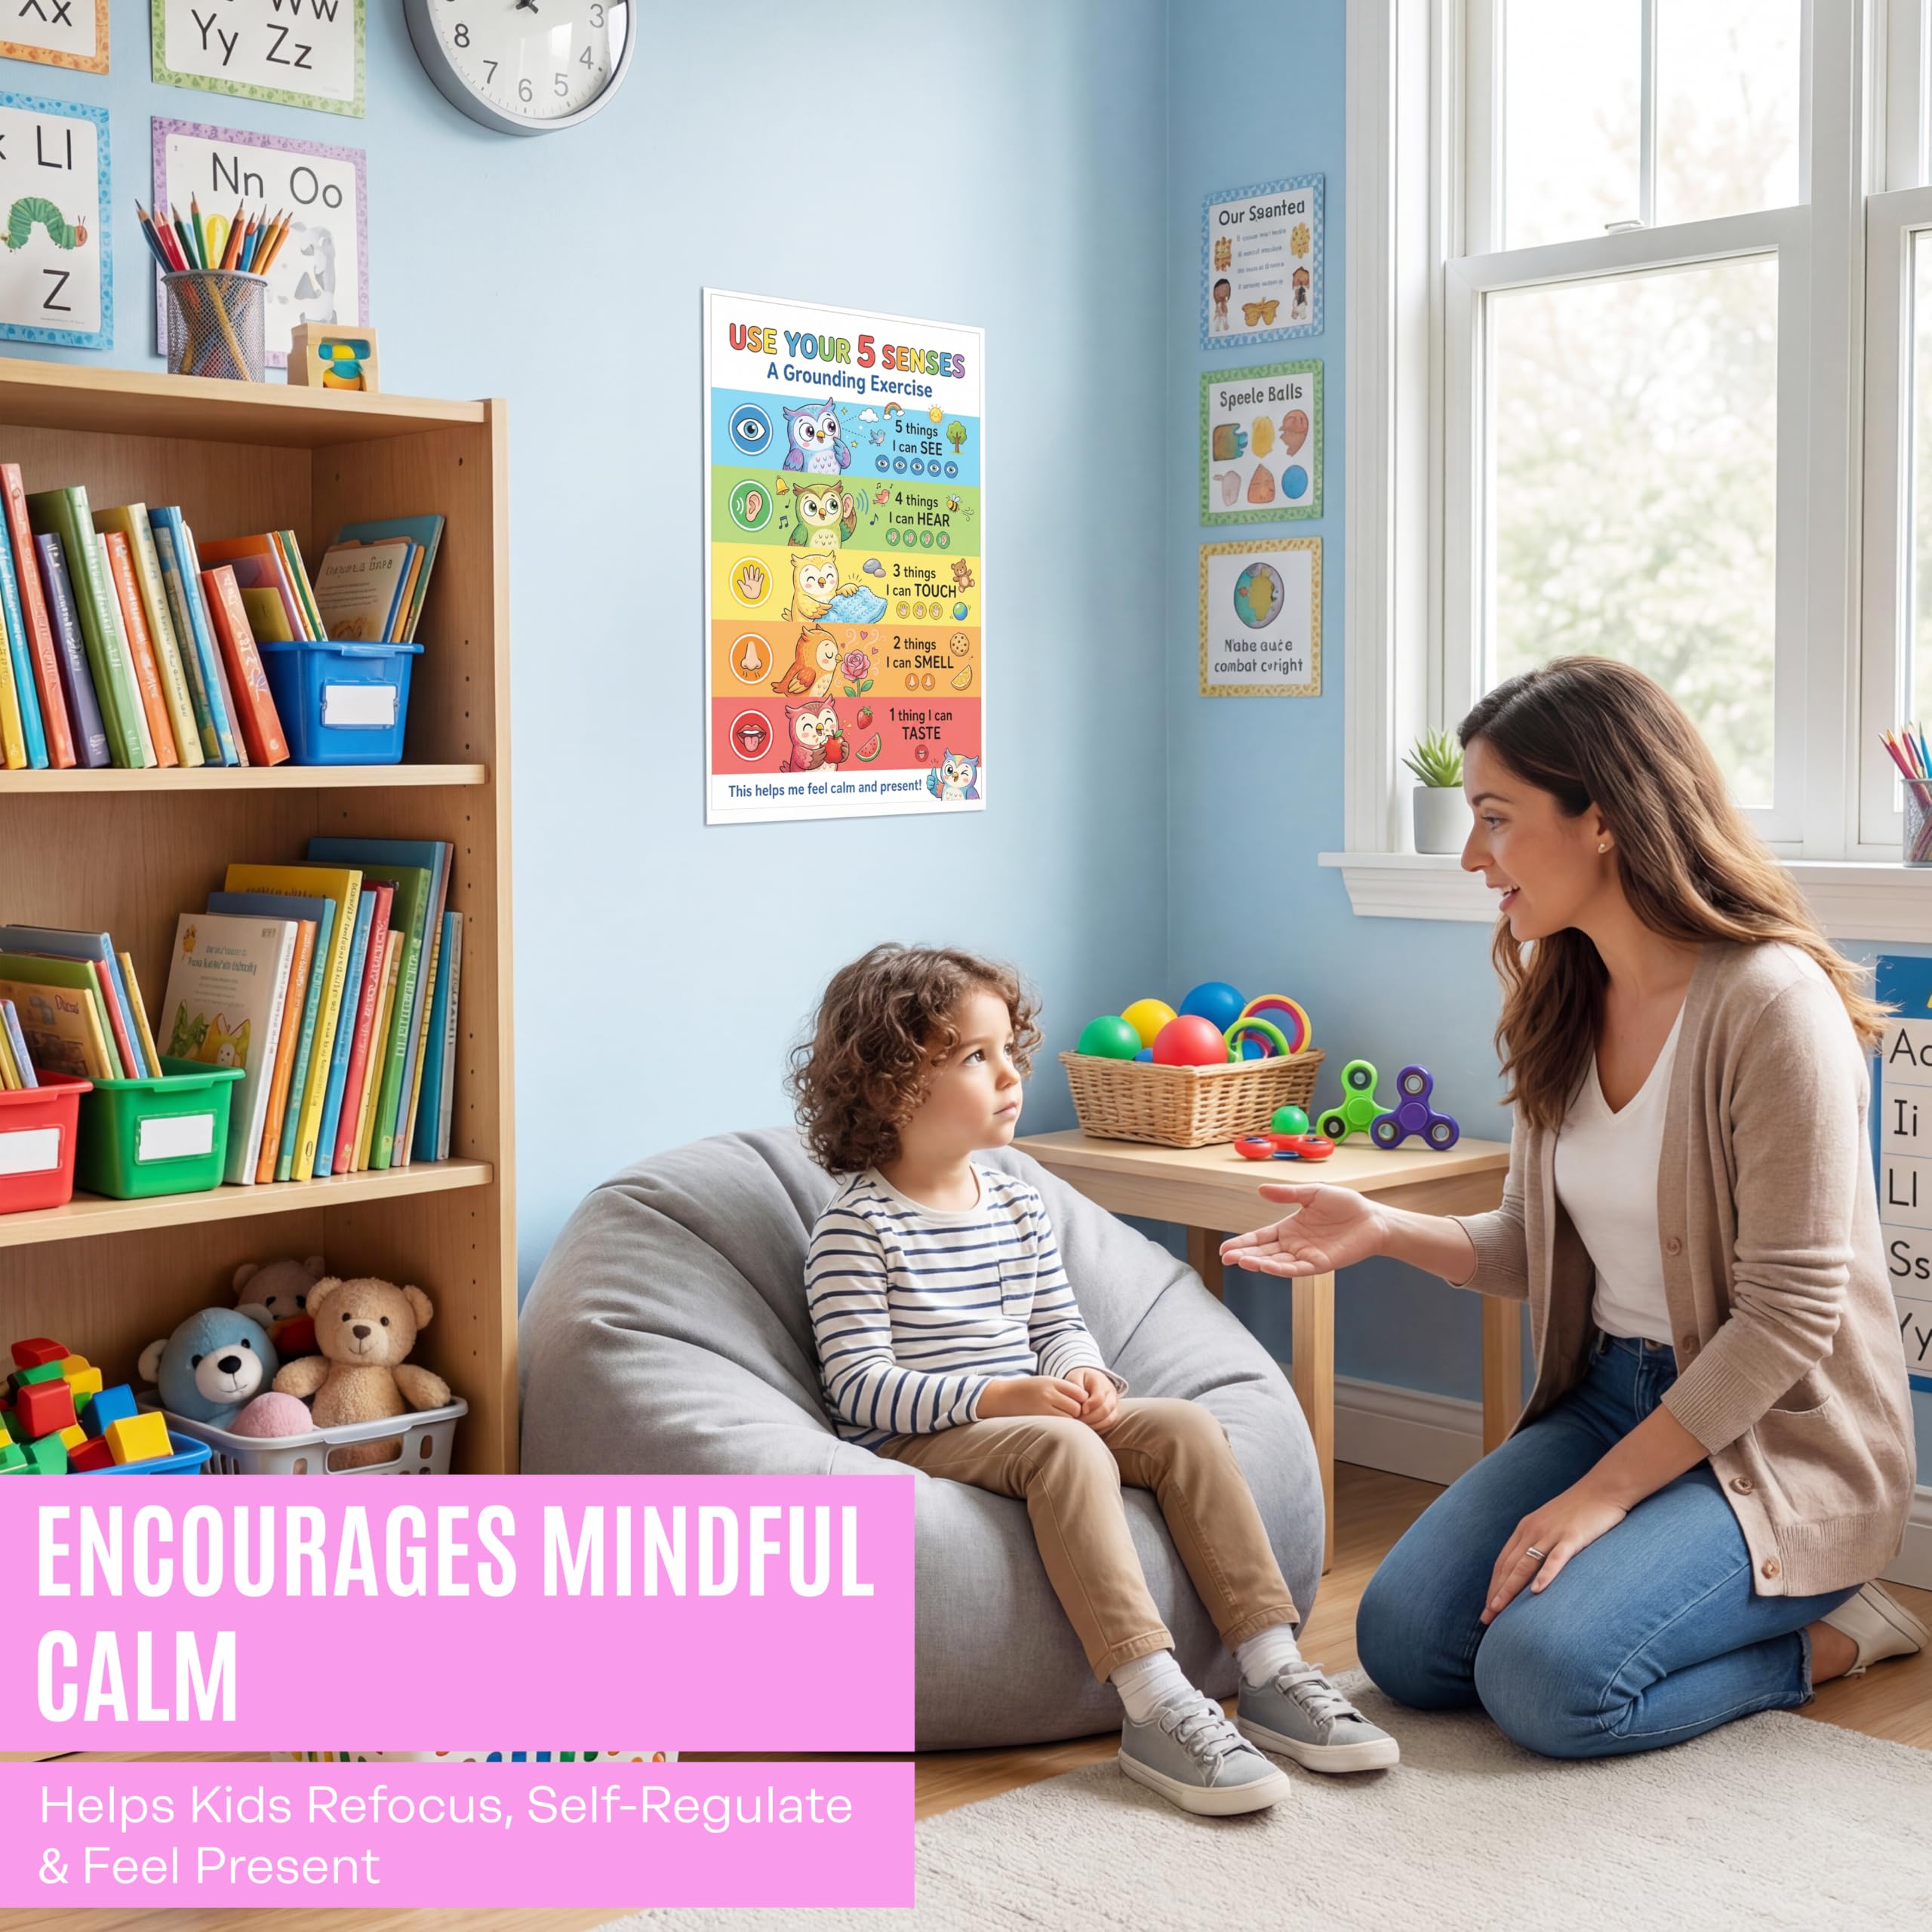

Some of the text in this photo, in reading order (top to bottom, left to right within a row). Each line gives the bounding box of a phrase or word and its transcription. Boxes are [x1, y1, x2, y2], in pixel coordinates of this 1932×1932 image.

[589, 3, 605, 29] 3
[191, 8, 312, 70] Yy Zz
[454, 23, 470, 48] 8
[579, 45, 595, 70] 4
[482, 60, 498, 85] 7
[518, 78, 533, 103] 6
[554, 72, 568, 97] 5
[212, 152, 343, 209] Nn Oo
[1218, 210, 1245, 226] Our
[729, 322, 966, 379] USE YOUR 5 SENSES
[767, 361, 933, 398] A Grounding Exercise
[1220, 383, 1303, 411] Speele Balls
[895, 420, 939, 439] 5 things
[893, 439, 943, 456] I can SEE
[895, 491, 939, 510] 4 things
[889, 511, 950, 527] I can HEAR
[893, 563, 937, 582] 3 things
[886, 583, 956, 598] I can TOUCH
[894, 635, 937, 654] 2 things
[886, 655, 954, 669] I can SMELL
[890, 707, 952, 724] 1 thing I can
[902, 726, 941, 740] TASTE
[728, 779, 922, 799] This helps me feel calm and present!
[1889, 1240, 1930, 1280] Ss
